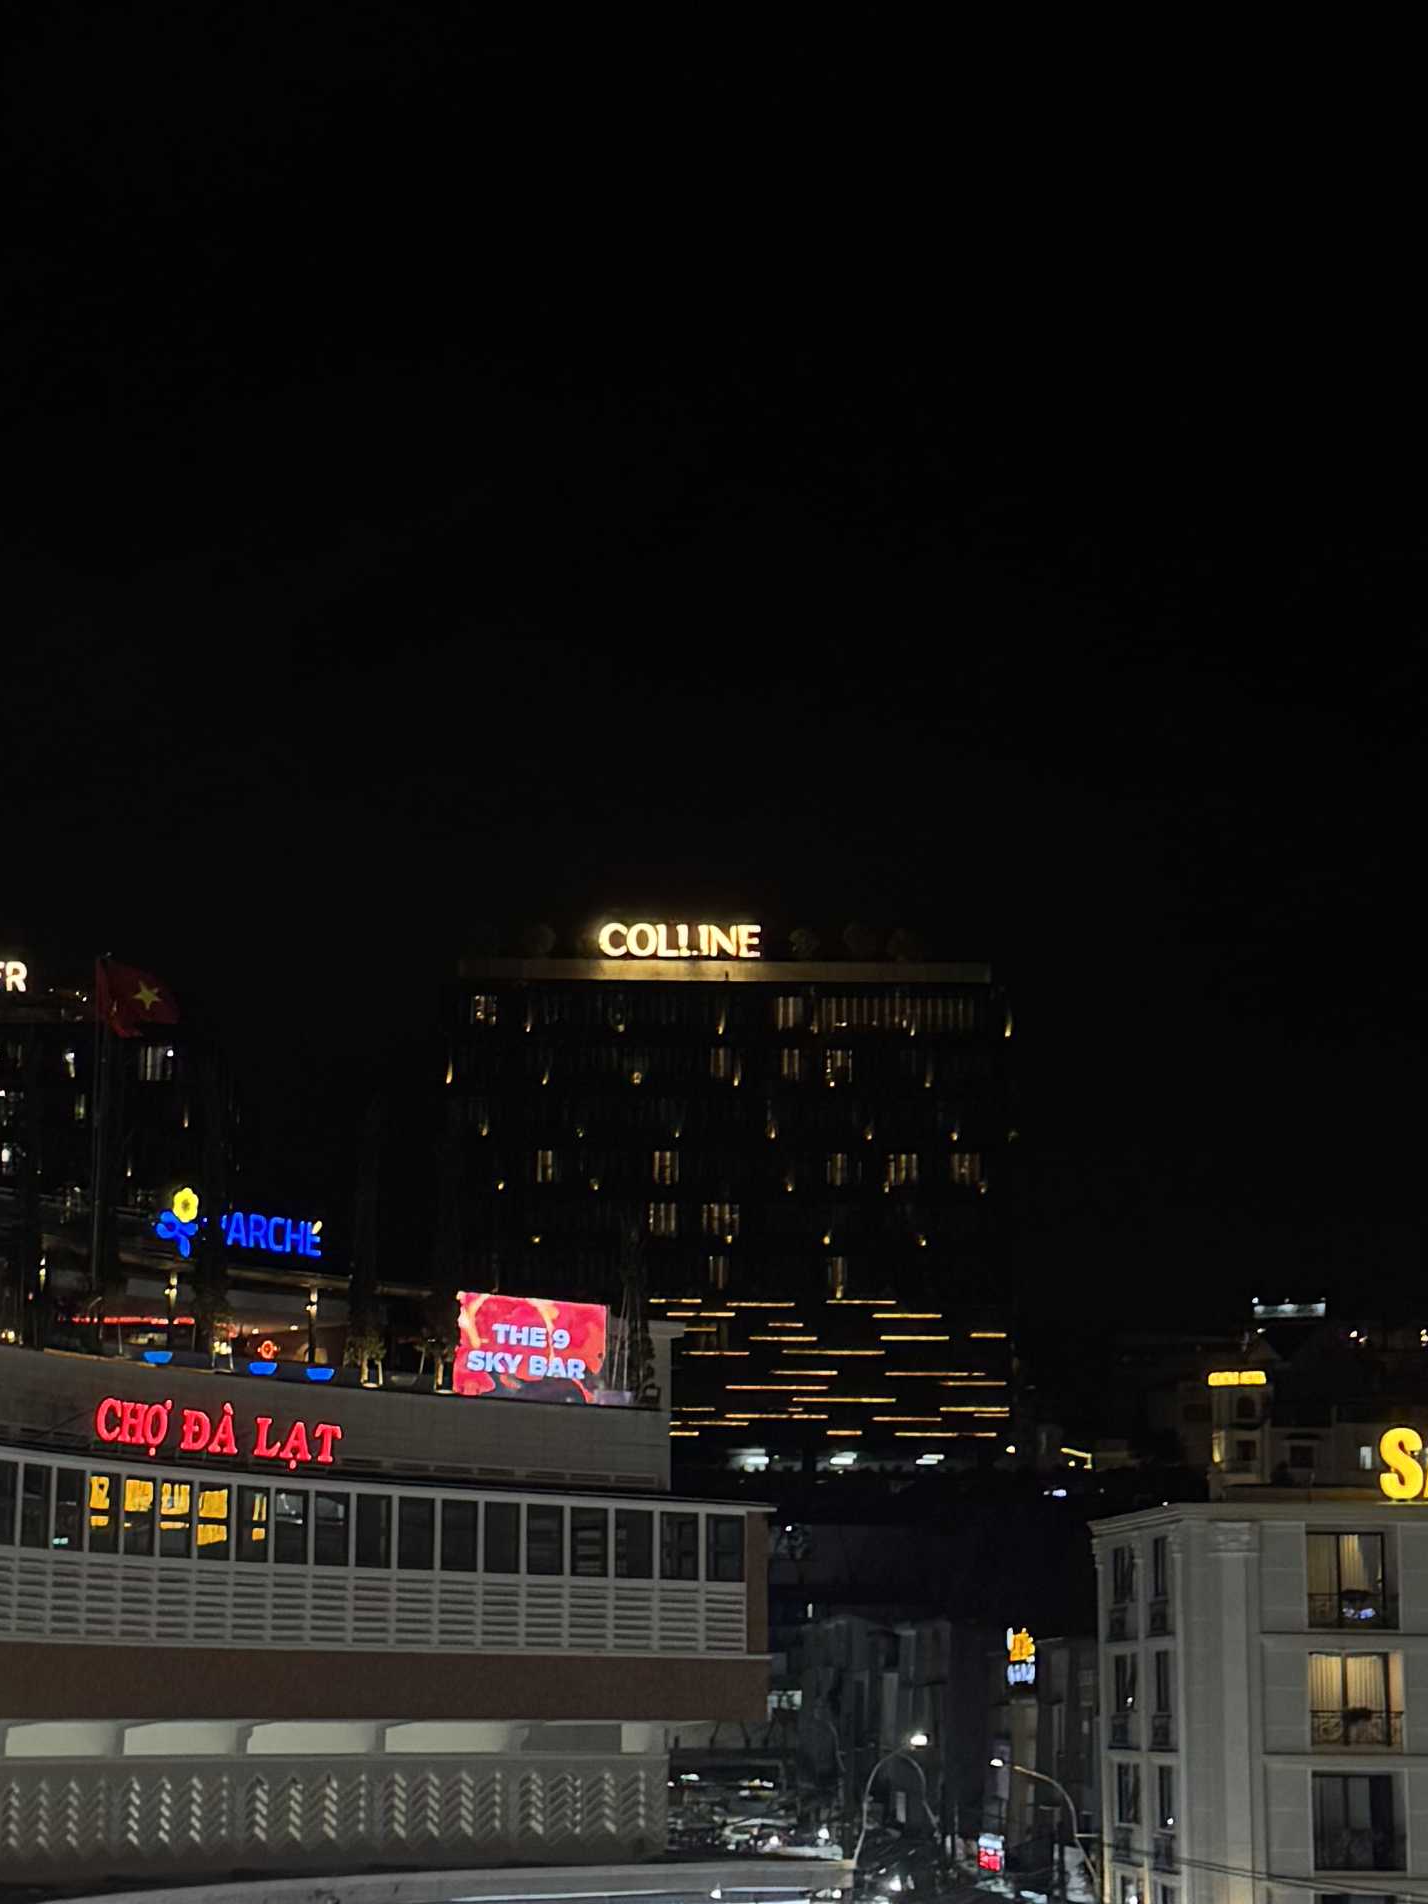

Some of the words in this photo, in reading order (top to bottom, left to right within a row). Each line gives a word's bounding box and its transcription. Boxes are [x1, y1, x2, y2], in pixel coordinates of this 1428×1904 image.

[221, 1211, 323, 1257] ARCHÉ
[492, 1323, 547, 1348] THE
[552, 1328, 570, 1349] 9
[466, 1349, 524, 1375] SKY
[528, 1355, 586, 1380] BAR
[96, 1397, 172, 1457] CHỢ
[180, 1402, 238, 1456] ĐÀ
[254, 1416, 342, 1470] LẠT
